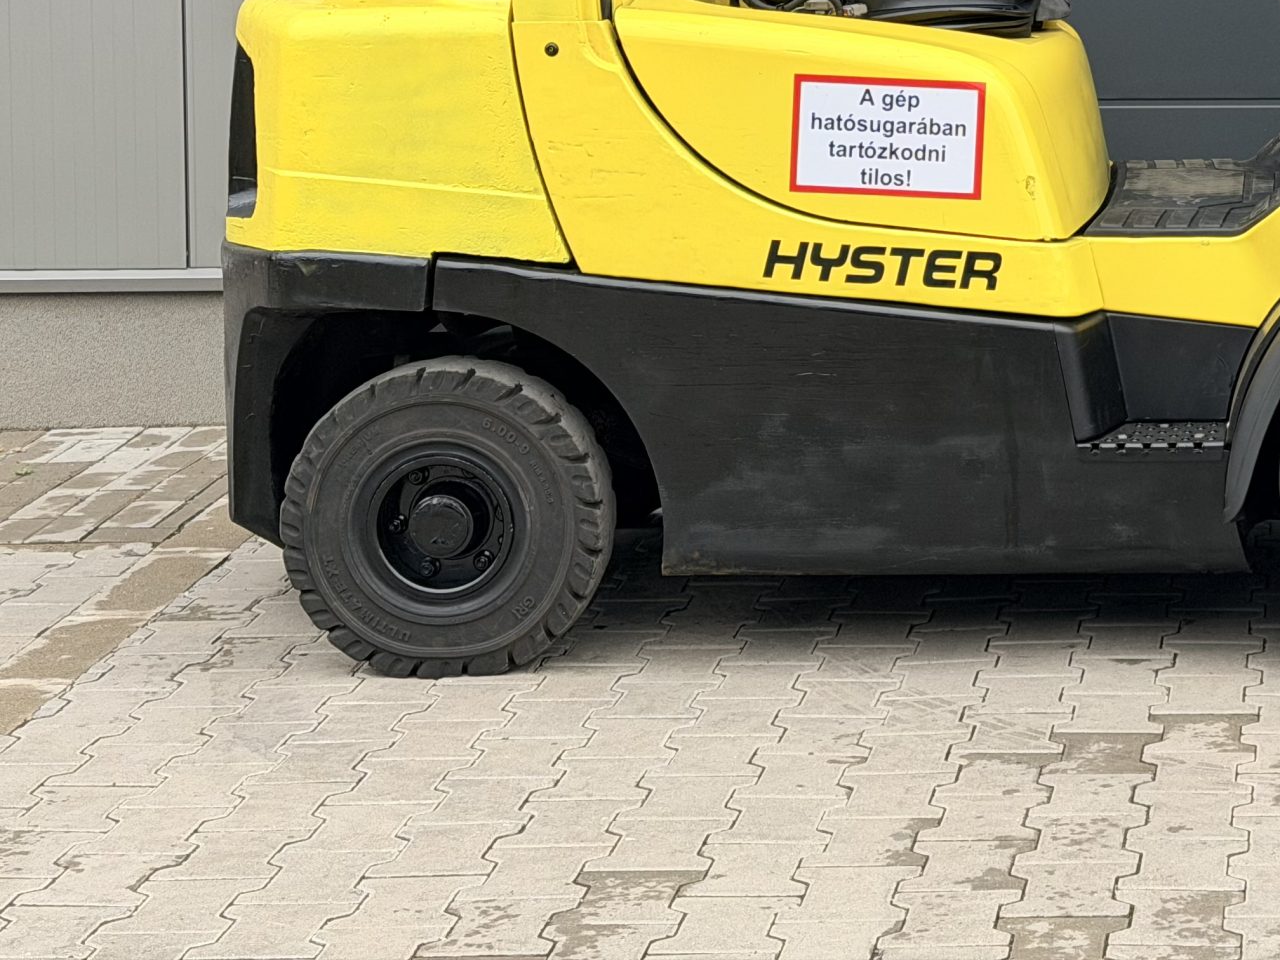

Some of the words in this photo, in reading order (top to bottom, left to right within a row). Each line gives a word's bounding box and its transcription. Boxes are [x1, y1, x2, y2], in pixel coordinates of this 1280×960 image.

[859, 89, 875, 106] A
[881, 90, 921, 112] gép
[810, 112, 967, 138] hatósugarában
[828, 141, 947, 162] tartózkodni
[860, 168, 912, 187] tilos!
[762, 239, 1003, 291] HYSTER
[482, 417, 530, 455] 6.00-9
[511, 595, 535, 619] GRI
